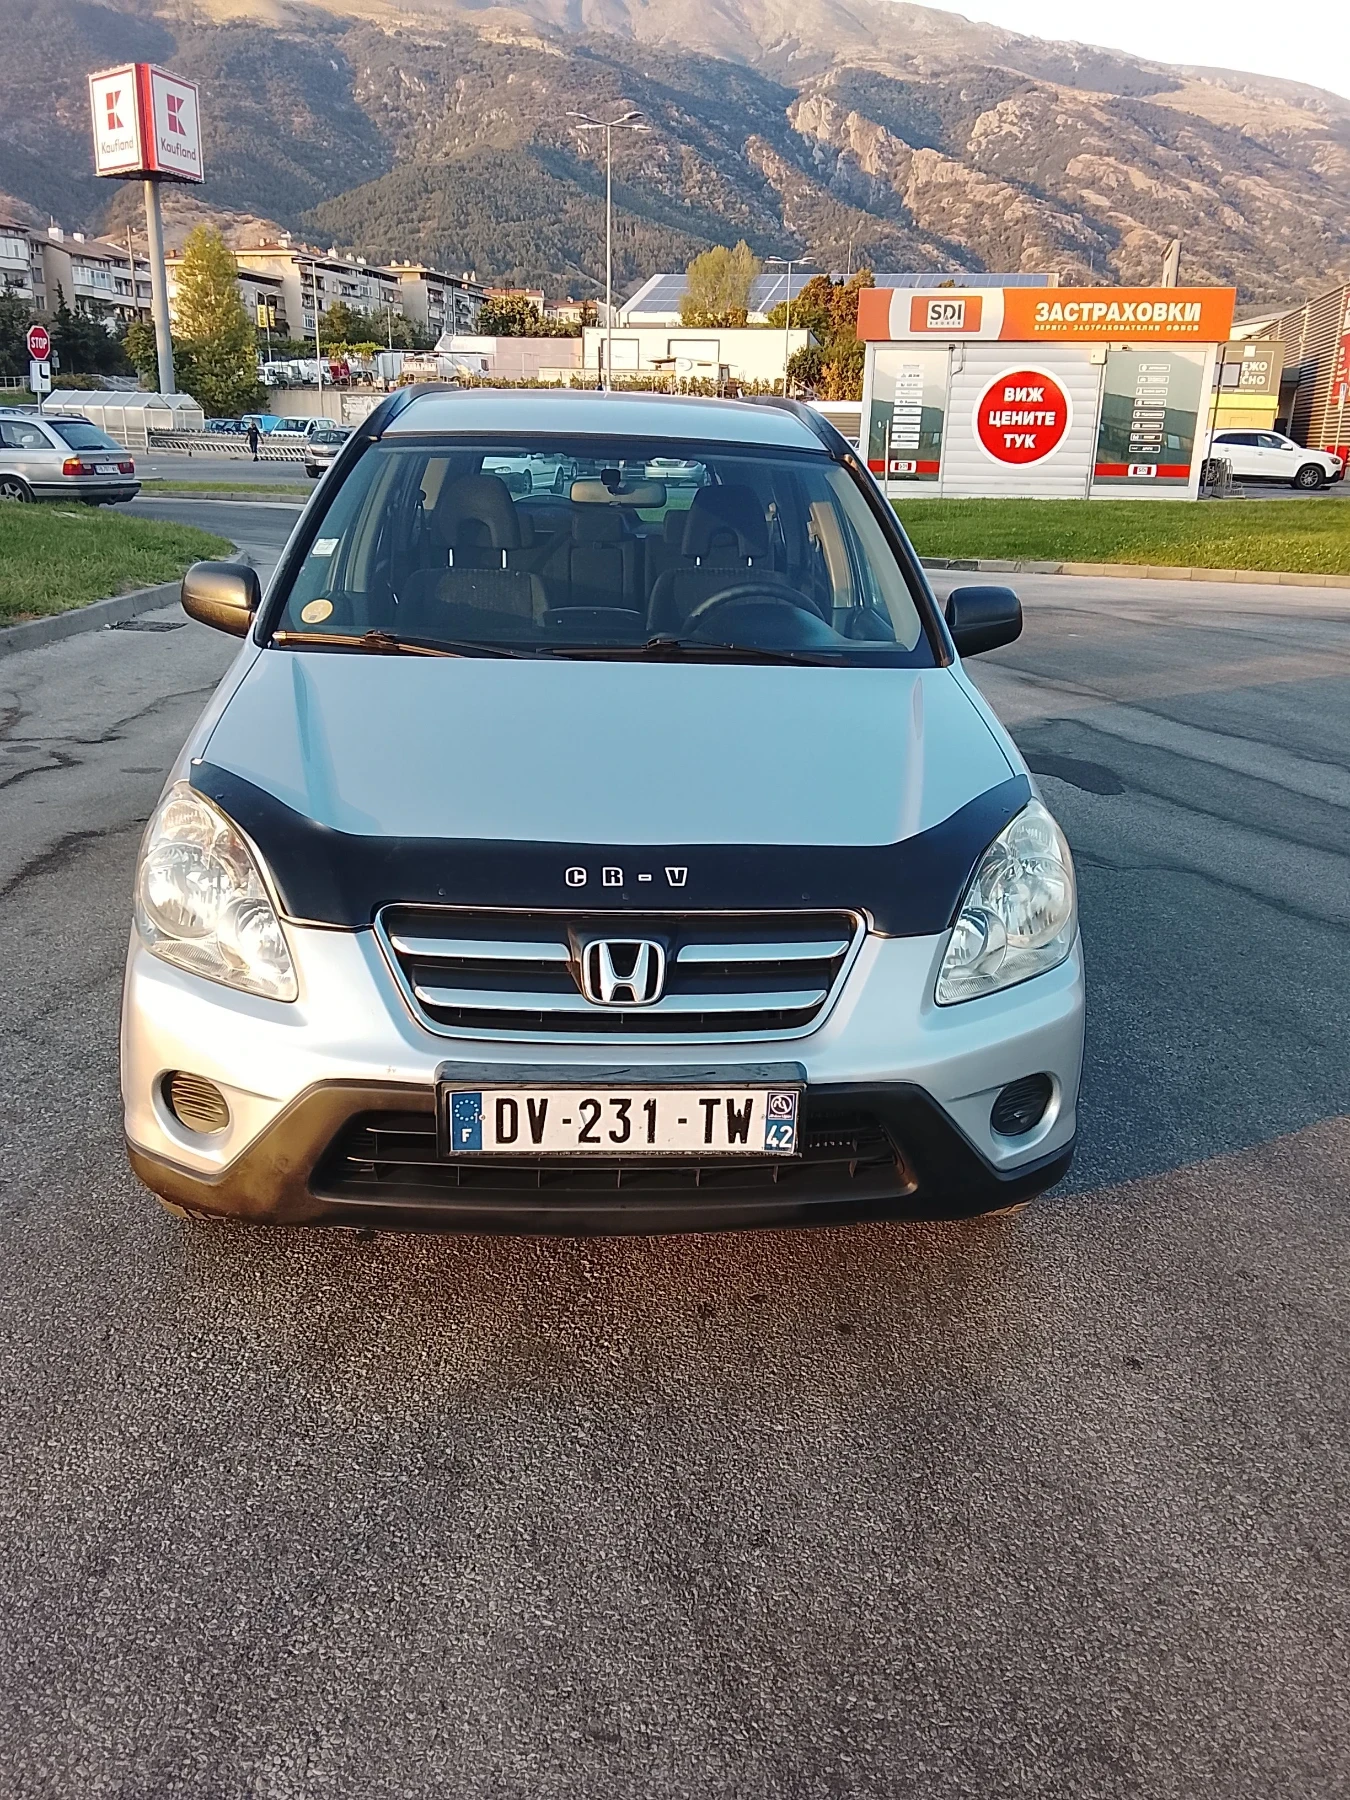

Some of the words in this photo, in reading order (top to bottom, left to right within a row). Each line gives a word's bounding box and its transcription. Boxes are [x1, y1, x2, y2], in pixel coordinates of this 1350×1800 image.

[101, 136, 134, 154] Kaufland
[160, 137, 196, 161] Kaufland
[930, 303, 962, 320] SDI
[1034, 301, 1202, 322] ЗАСТРАХОВКИ
[31, 337, 47, 349] STOP
[1241, 361, 1268, 372] ЕЖО
[1240, 375, 1266, 385] СНО
[1003, 387, 1045, 403] ВИЖ
[988, 410, 1056, 427] ЦЕНИТЕ
[1003, 434, 1037, 449] ТУК
[565, 866, 688, 886] CR-V
[495, 1098, 754, 1145] DV-231-TW
[462, 1128, 473, 1143] F
[766, 1124, 793, 1148] 42
